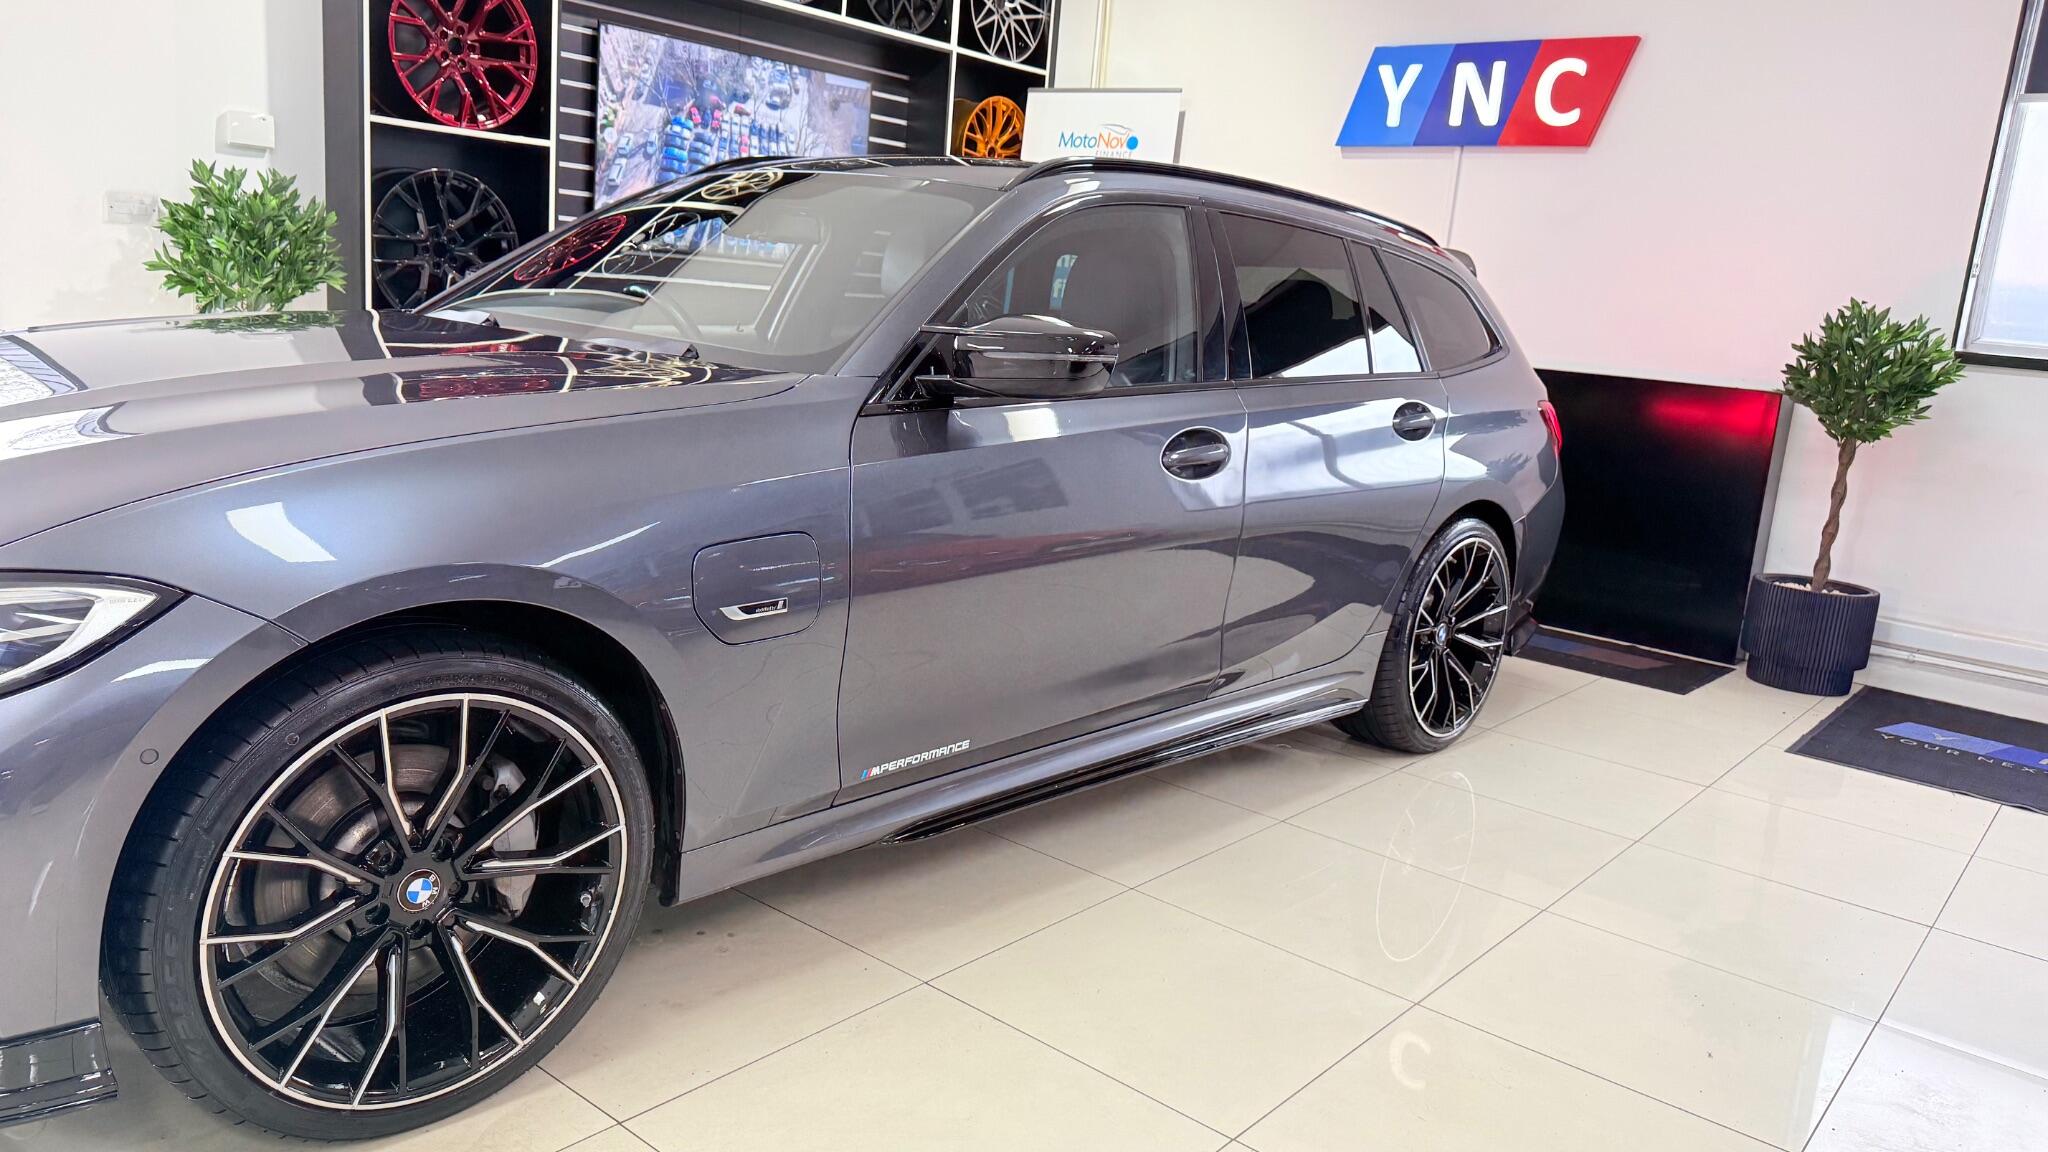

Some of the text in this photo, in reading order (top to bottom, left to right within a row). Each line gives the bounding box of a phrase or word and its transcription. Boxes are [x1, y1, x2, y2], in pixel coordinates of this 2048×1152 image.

[1377, 57, 1588, 128] YNC
[1881, 733, 2048, 774] YOUR NEX
[421, 873, 439, 908] BMW
